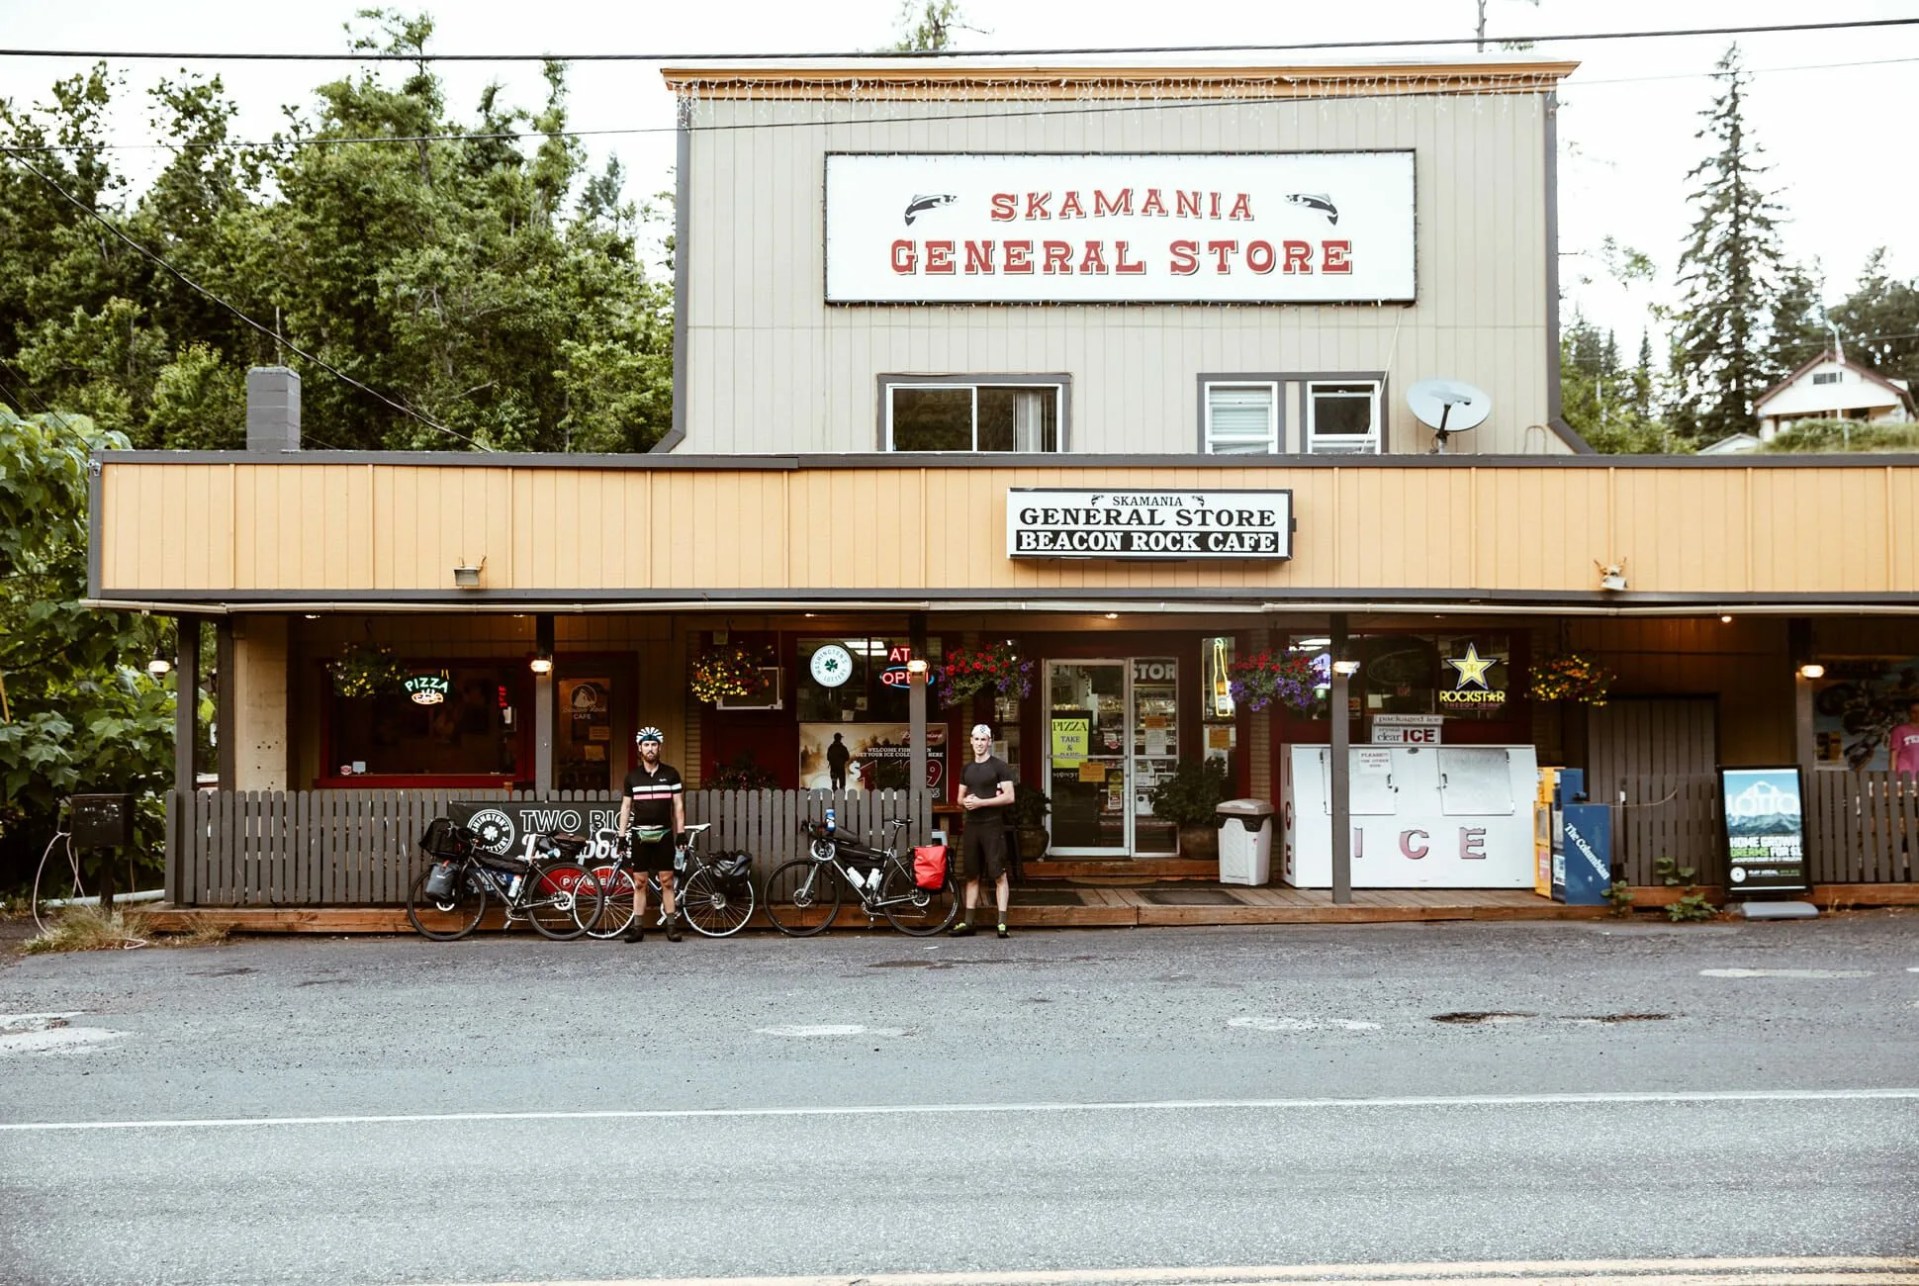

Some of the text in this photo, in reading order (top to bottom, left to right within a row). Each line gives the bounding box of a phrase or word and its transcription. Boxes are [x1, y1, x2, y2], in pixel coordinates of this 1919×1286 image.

[990, 188, 1254, 221] SKAMANIA
[890, 239, 1353, 276] GENERAL STORE
[1112, 495, 1183, 507] SKAMANIA
[1019, 507, 1276, 527] GENERAL STORE
[1019, 531, 1276, 552] BEACON ROCK CAFE
[890, 648, 911, 662] AT
[405, 677, 449, 693] PIZZA
[1052, 721, 1087, 732] PIZZA
[1377, 729, 1435, 742] clear ICE
[520, 809, 582, 832] TWO
[1354, 827, 1486, 859] ICE
[1564, 822, 1611, 880] The Columbian
[1729, 836, 1759, 848] HOME
